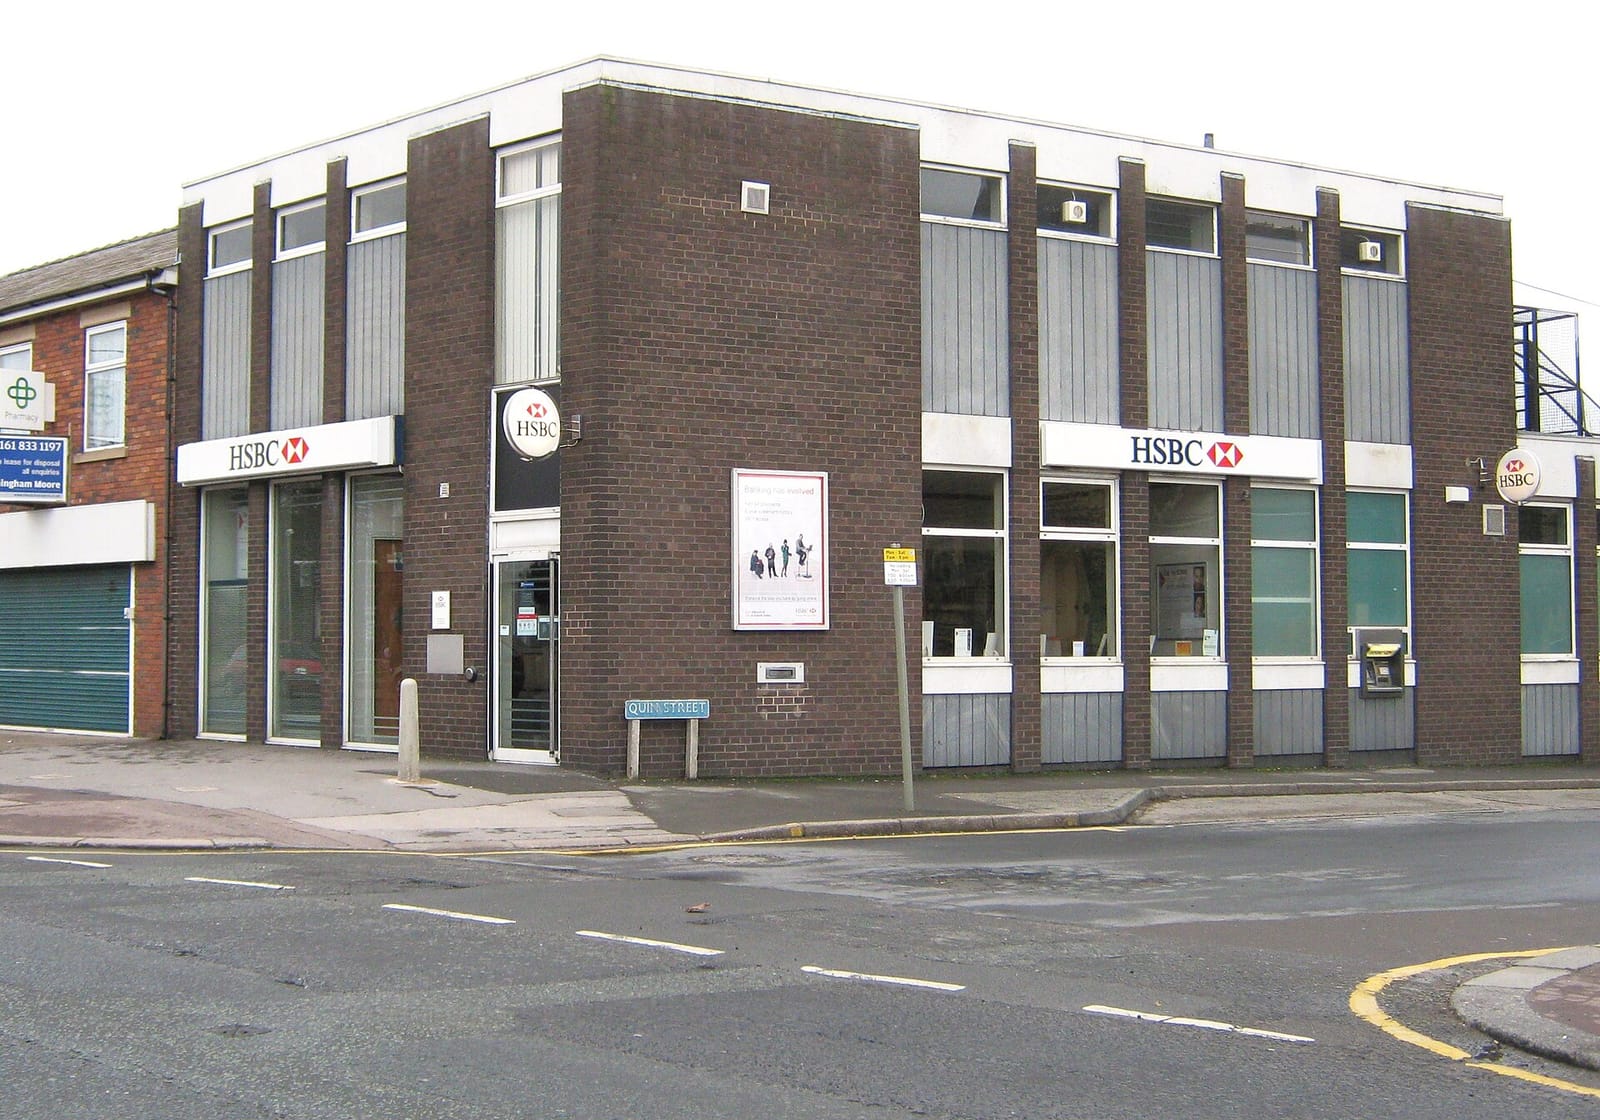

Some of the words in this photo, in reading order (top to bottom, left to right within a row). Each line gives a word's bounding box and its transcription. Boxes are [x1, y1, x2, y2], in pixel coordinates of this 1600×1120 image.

[517, 420, 557, 438] HSBC
[18, 441, 37, 451] 833
[39, 442, 62, 452] 1197
[1131, 436, 1203, 466] HSBC
[229, 440, 279, 470] HSBC
[34, 459, 60, 467] disposal
[31, 468, 60, 476] enquiries
[34, 480, 61, 489] Moore
[1499, 472, 1534, 488] HSBC
[663, 702, 706, 713] STREET
